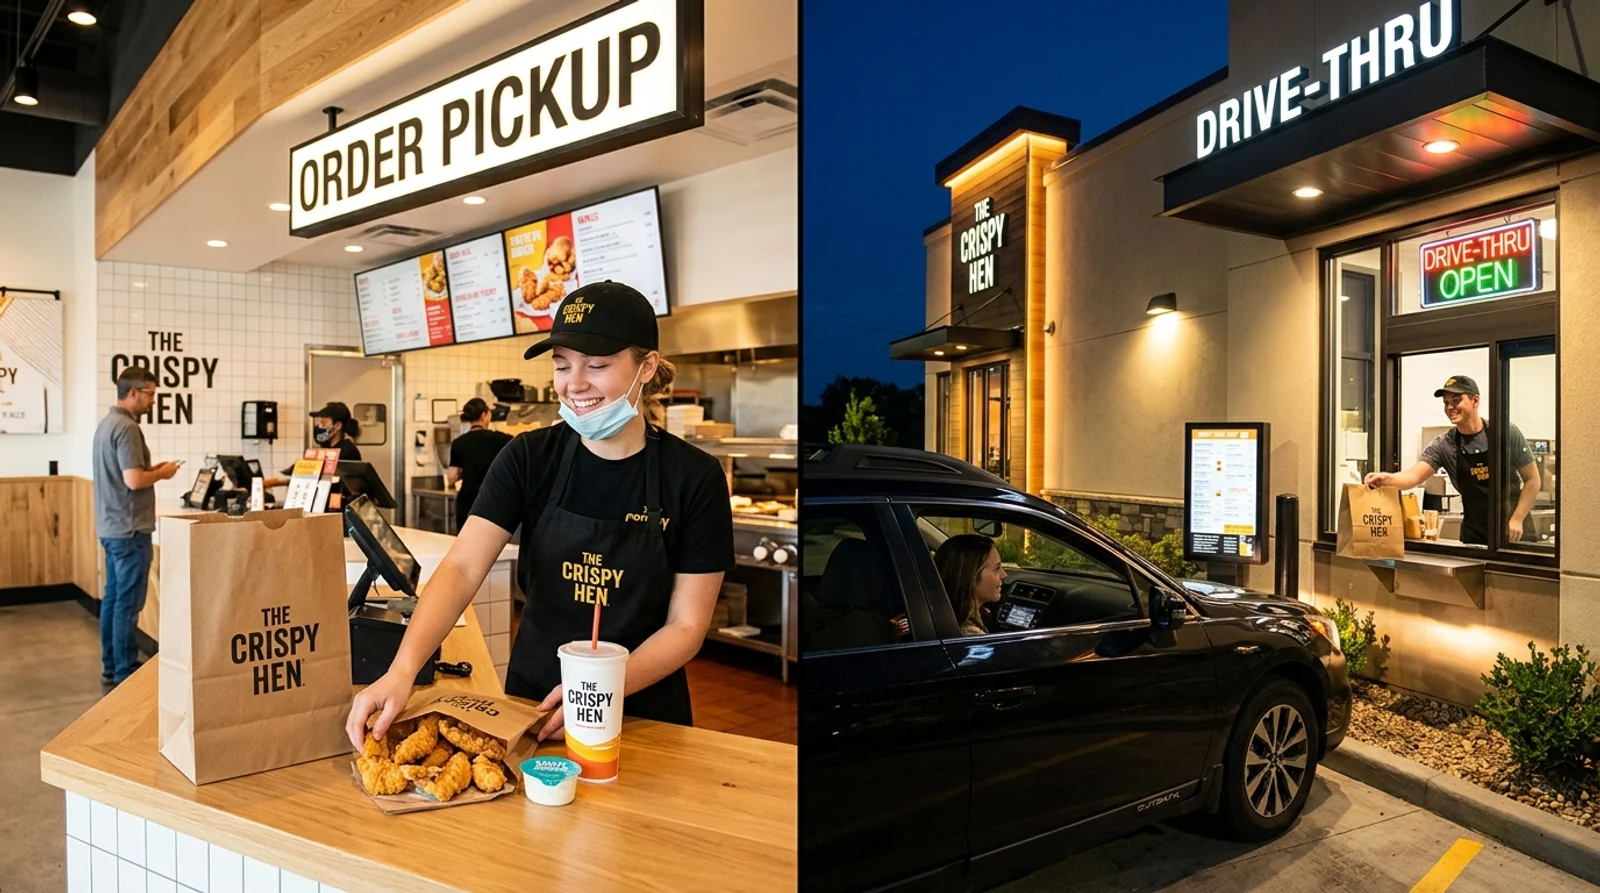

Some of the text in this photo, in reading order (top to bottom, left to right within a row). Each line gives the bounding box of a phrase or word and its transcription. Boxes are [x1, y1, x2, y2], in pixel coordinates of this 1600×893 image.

[1197, 0, 1453, 160] DRIVE-THRU
[300, 21, 661, 212] ORDER PICKUP
[974, 197, 990, 222] THE
[960, 213, 1005, 263] CRISPY
[1424, 227, 1531, 270] DRIVE-THRU
[968, 254, 994, 294] HEN
[1440, 258, 1513, 299] OPEN
[148, 331, 183, 352] THE
[1362, 514, 1392, 526] CRISPY
[562, 561, 624, 588] CRISPY
[574, 582, 608, 606] HEN
[261, 605, 290, 626] THE
[231, 623, 320, 664] CRISPY
[253, 658, 302, 696] HEN
[580, 681, 597, 691] THE
[568, 689, 613, 707] CRISPY
[577, 707, 603, 723] HEN
